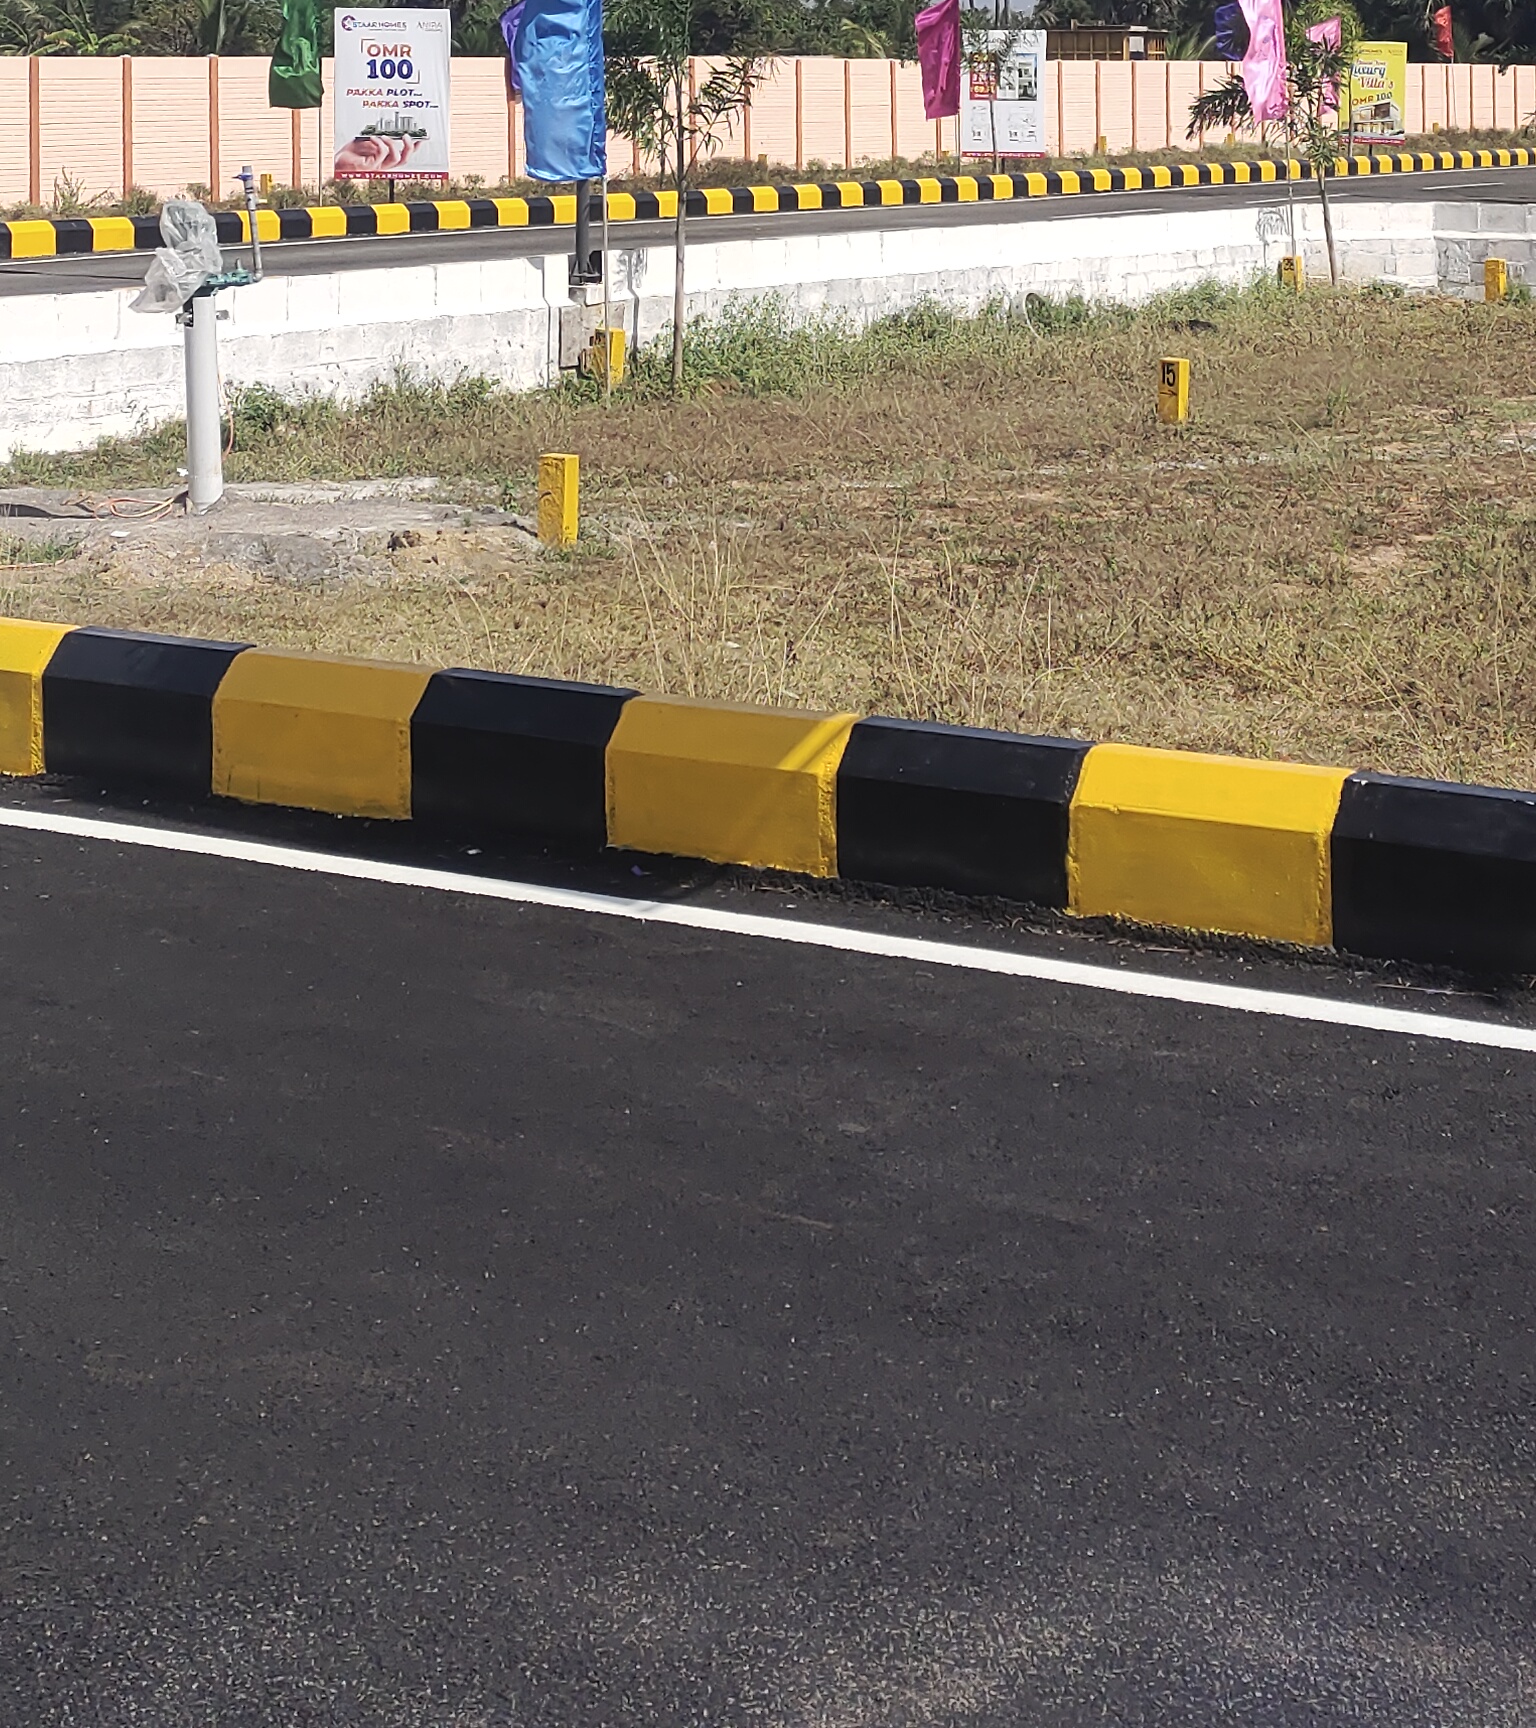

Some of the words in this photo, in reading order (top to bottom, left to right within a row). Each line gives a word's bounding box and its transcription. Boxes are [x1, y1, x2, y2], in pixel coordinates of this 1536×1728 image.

[366, 43, 412, 57] OMR
[366, 59, 413, 79] 100
[346, 88, 383, 97] PAKKA
[1351, 95, 1374, 106] OMR
[1376, 91, 1393, 102] 100
[362, 101, 399, 109] PAKKA
[1161, 362, 1176, 387] 15
